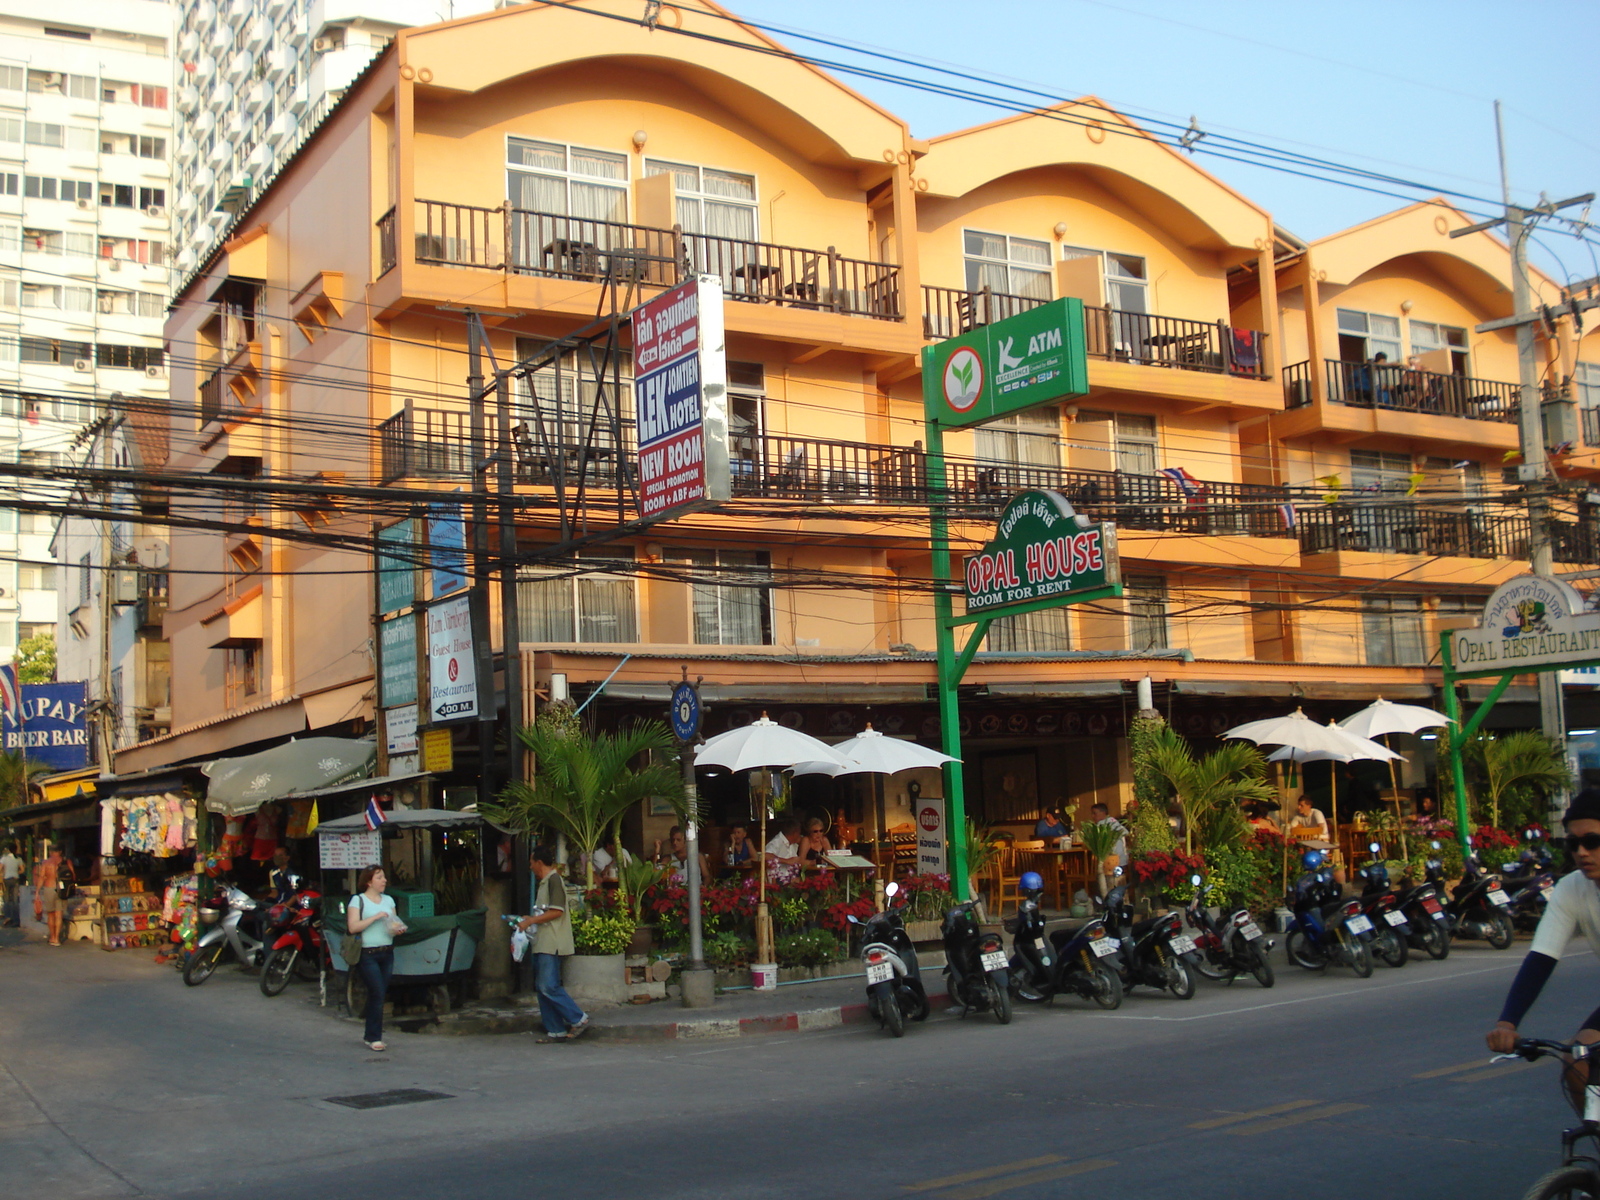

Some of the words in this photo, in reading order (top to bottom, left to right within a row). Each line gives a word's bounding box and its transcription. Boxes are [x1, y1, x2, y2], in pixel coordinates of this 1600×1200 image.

[637, 308, 653, 346] เล็ก
[656, 290, 697, 336] จอมเทียน
[658, 329, 682, 362] โฮเต็ล
[1028, 327, 1062, 356] ATM
[668, 356, 698, 396] JOMTIEN
[997, 367, 1029, 383] EXCELLENCE
[638, 371, 669, 443] LEK
[670, 394, 700, 430] HOTEL
[641, 448, 664, 482] NEW
[668, 434, 702, 473] ROOM
[646, 480, 666, 496] SPECIAL
[666, 468, 699, 488] PROMOTION
[644, 494, 666, 513] ROOM
[672, 486, 687, 503] ABF
[688, 484, 704, 499] daily
[1000, 496, 1030, 540] โอปอล์
[967, 548, 1020, 595] OPAL
[1026, 530, 1103, 584] HOUSE
[968, 591, 1003, 608] ROOM
[1007, 587, 1033, 601] FOR
[1037, 580, 1072, 596] RENT
[432, 643, 450, 657] Guest
[453, 638, 471, 652] House
[432, 682, 475, 699] Restaurant
[440, 704, 458, 714] 300
[460, 702, 472, 712] M.
[7, 731, 49, 748] BEER
[52, 729, 86, 746] BAR
[921, 811, 939, 826] บริการ
[920, 836, 941, 849] ห้องพัก
